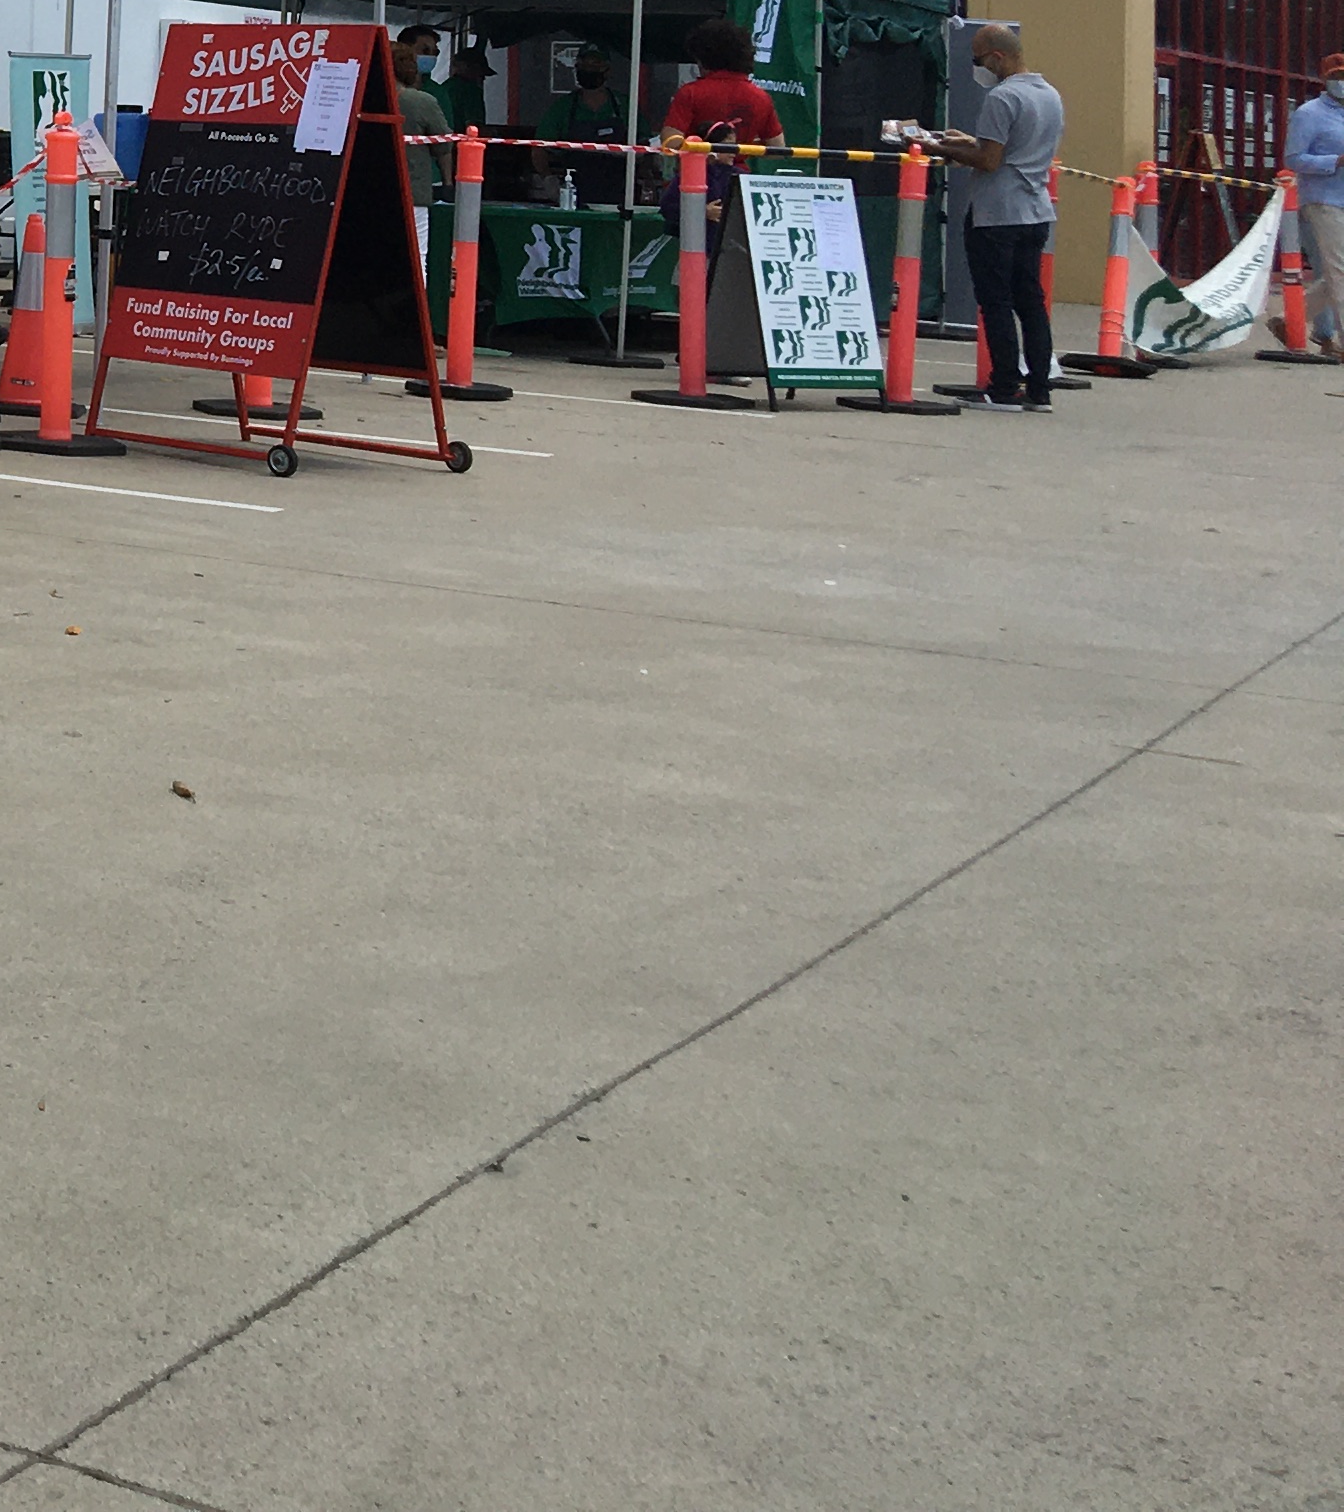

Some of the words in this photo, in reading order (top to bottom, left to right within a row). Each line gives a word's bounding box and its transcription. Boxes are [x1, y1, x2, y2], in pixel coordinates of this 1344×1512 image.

[189, 29, 330, 78] SAUSAGE
[182, 75, 275, 115] SIZZLE
[208, 130, 220, 140] All
[254, 132, 267, 143] Go
[143, 164, 326, 204] NEIGHBOURHOOD
[135, 208, 211, 242] WATCH
[224, 212, 295, 248] RYDE
[126, 297, 163, 316] Fund
[166, 301, 220, 326] Raising
[224, 307, 249, 325] For
[253, 310, 294, 330] Local
[133, 320, 217, 349] Community
[220, 330, 275, 355] Groups
[144, 345, 172, 358] Proudly
[172, 348, 210, 361] Supported
[210, 352, 220, 363] By
